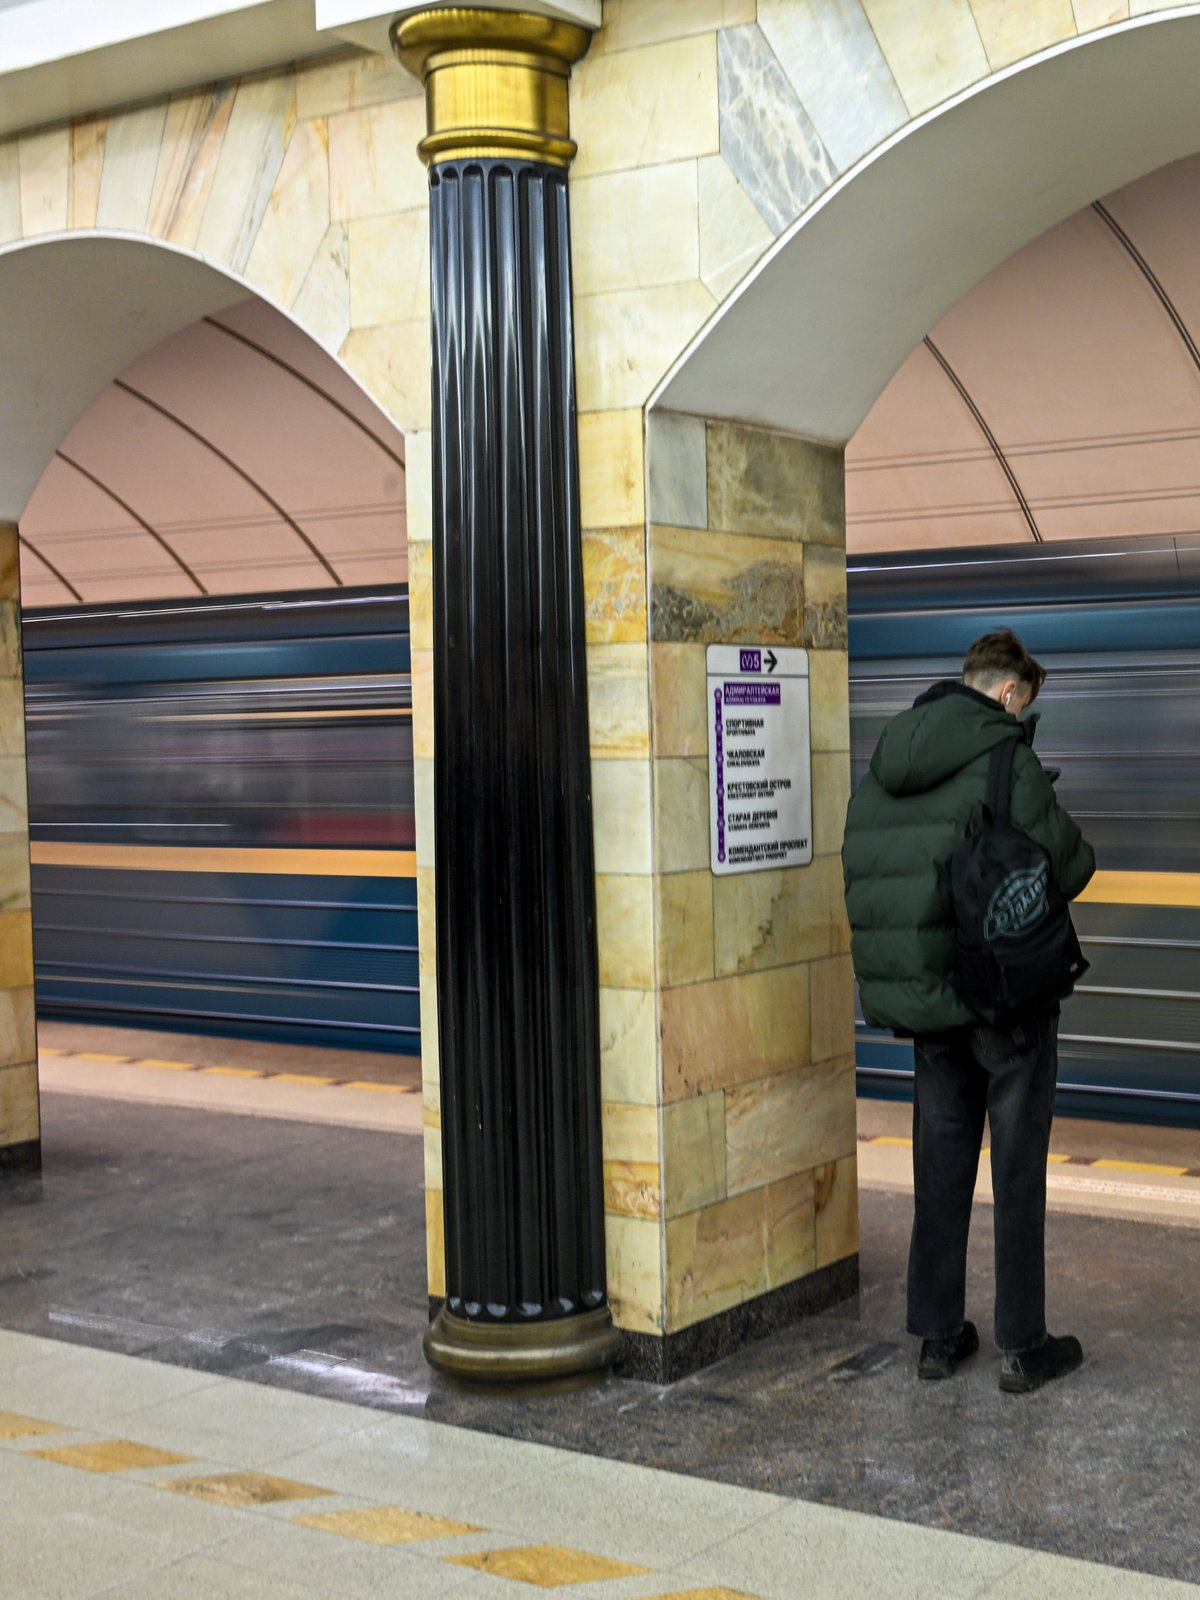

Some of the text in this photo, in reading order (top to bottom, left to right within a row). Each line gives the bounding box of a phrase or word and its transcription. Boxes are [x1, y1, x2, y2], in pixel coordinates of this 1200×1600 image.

[753, 653, 760, 670] 5
[725, 684, 780, 697] АДМИРАЛТЕЙСКАЯ
[726, 718, 764, 728] СПОРТИВНАЯ
[727, 749, 765, 759] ЧКАЛОВСКАЯ
[727, 779, 791, 792] КРЕСТОВСКИЙ ОСТРОВ
[728, 809, 778, 823] СТАРАЯ ДЕРЕВНЯ
[728, 838, 807, 856] КОМЕНДАНТСКИЙ ПРОСПЕКТ
